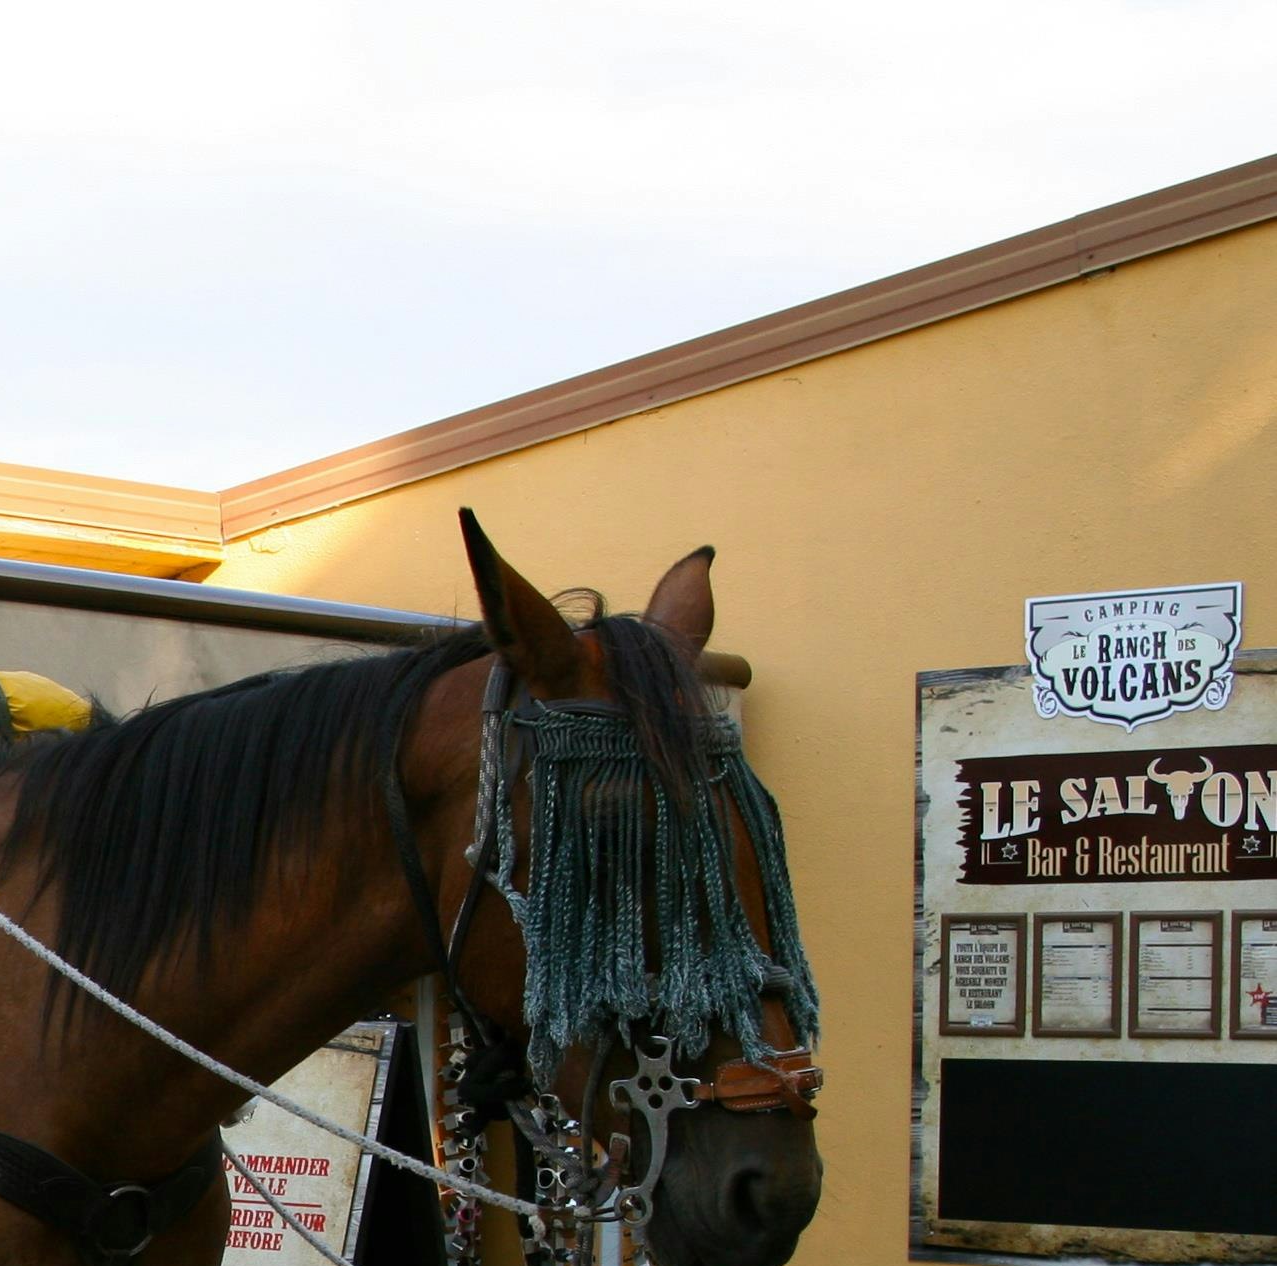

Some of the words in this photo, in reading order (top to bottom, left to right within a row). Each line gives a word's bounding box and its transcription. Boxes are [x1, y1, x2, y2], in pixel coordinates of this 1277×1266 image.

[1084, 600, 1181, 622] CAMPING
[1073, 644, 1086, 660] LE
[1098, 630, 1168, 664] RANCH
[1177, 638, 1196, 651] DES
[1061, 659, 1202, 702] VOLCANS
[979, 780, 1042, 841] LE
[1026, 837, 1068, 878] Bar
[1075, 836, 1091, 876] &
[1098, 833, 1231, 876] Restaurant
[234, 1175, 288, 1196] VELE
[231, 1208, 274, 1229] RDER
